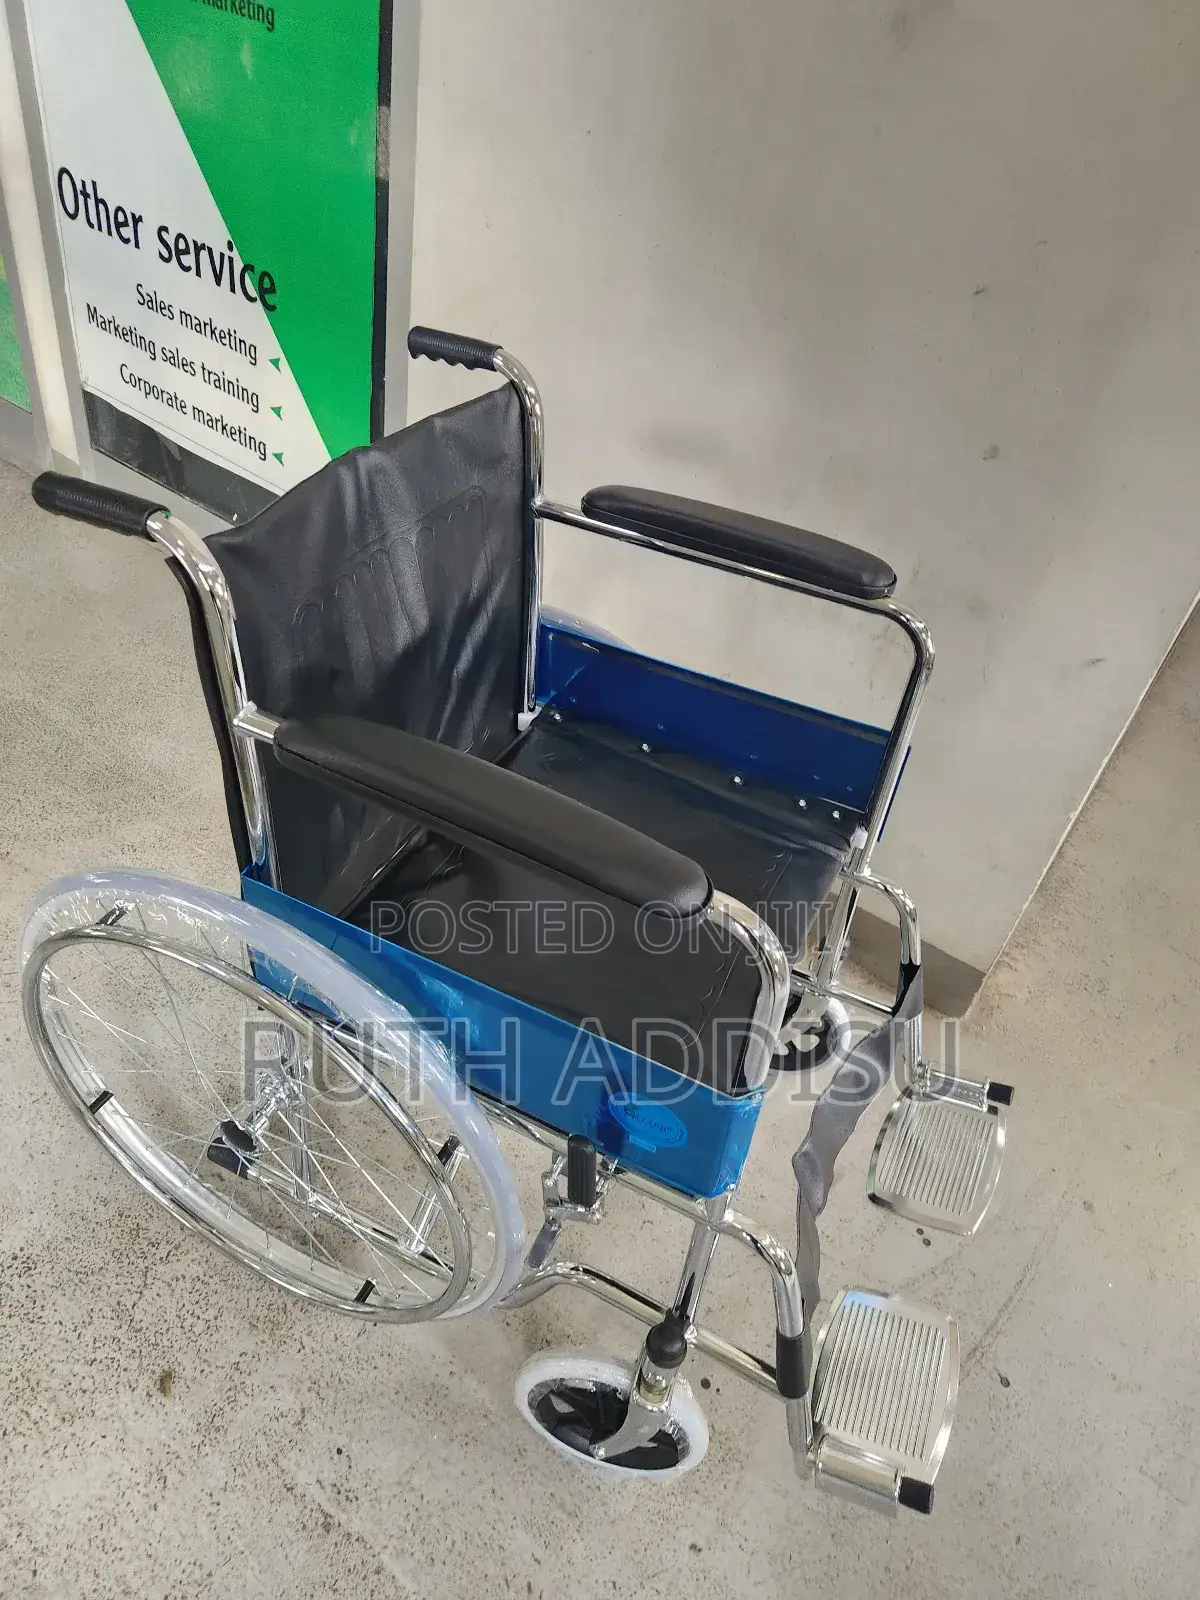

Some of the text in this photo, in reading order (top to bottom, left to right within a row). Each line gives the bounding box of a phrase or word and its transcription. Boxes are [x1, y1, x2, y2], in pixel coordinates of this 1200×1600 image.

[58, 166, 278, 313] Other service
[86, 302, 260, 413] Marketing sales training
[136, 283, 258, 366] Sales marketing
[119, 363, 267, 461] Corporate marketing
